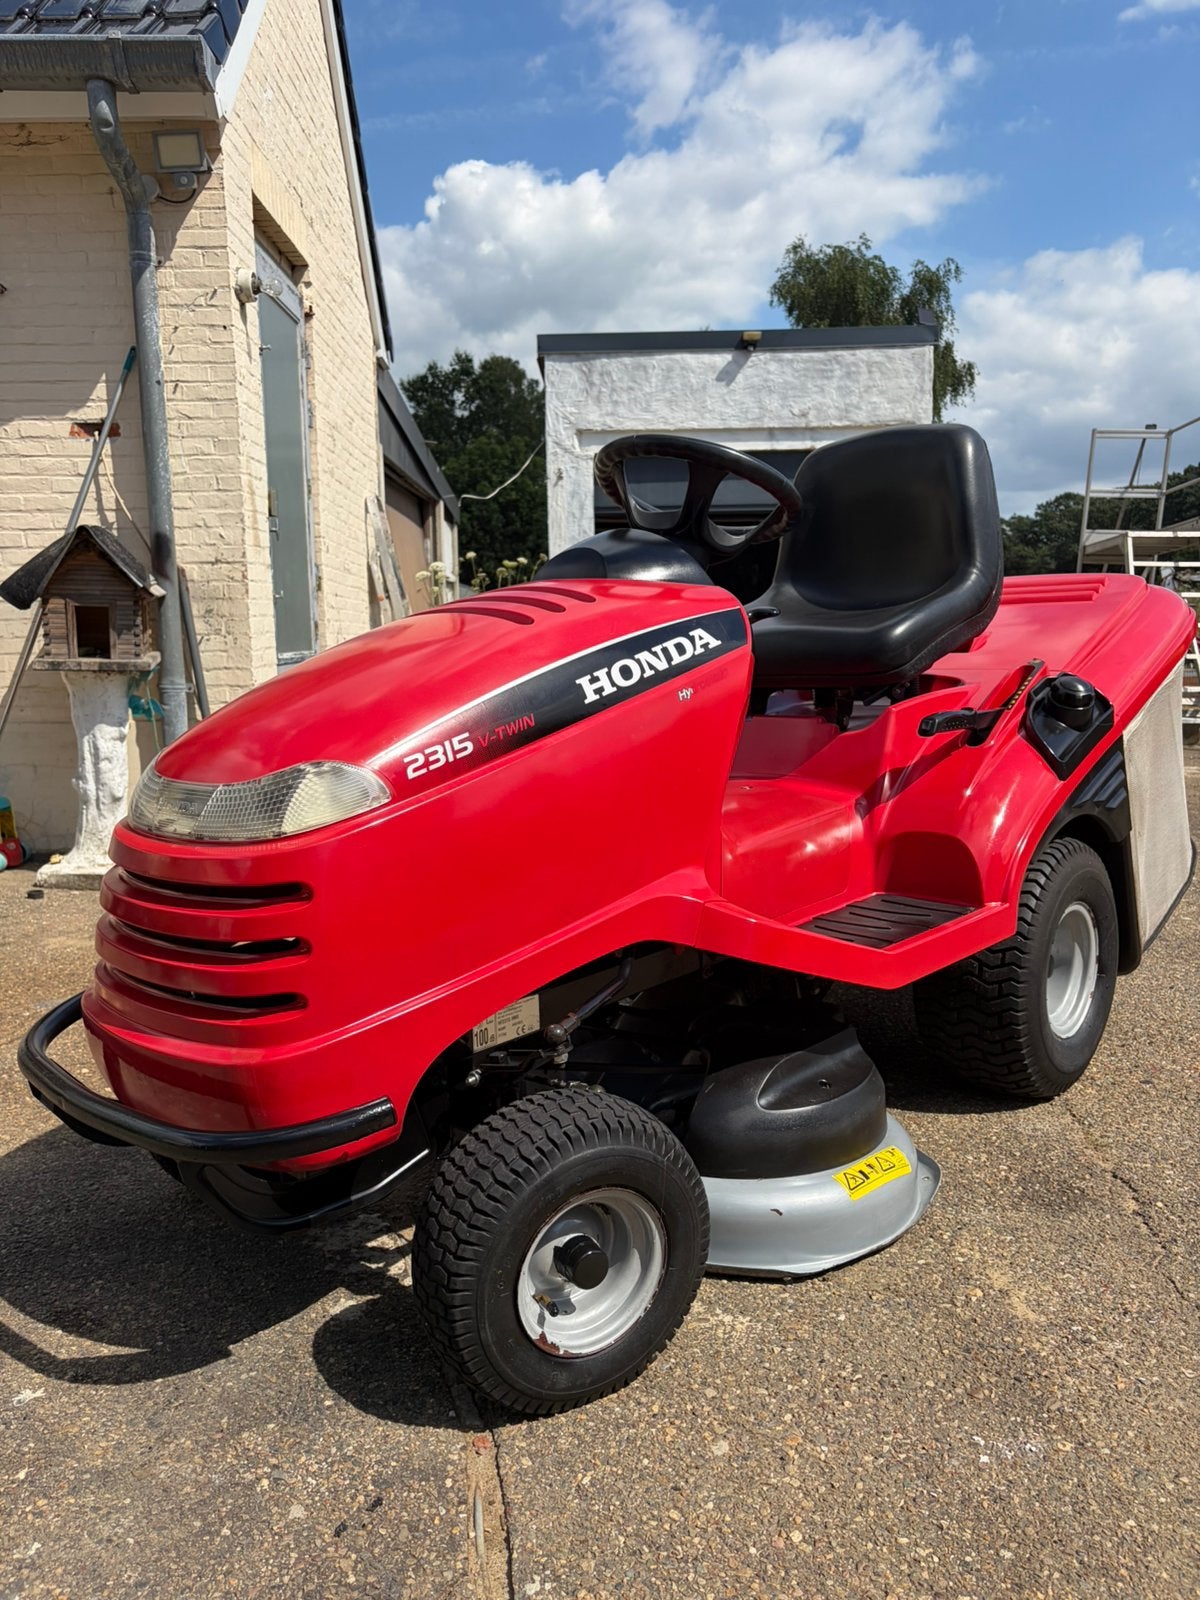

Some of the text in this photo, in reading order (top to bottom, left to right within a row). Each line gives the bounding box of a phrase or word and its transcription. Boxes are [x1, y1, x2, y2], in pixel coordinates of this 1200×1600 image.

[575, 628, 722, 704] HONDA
[403, 713, 535, 780] 2315 V-TWIN
[474, 1027, 488, 1047] 100
